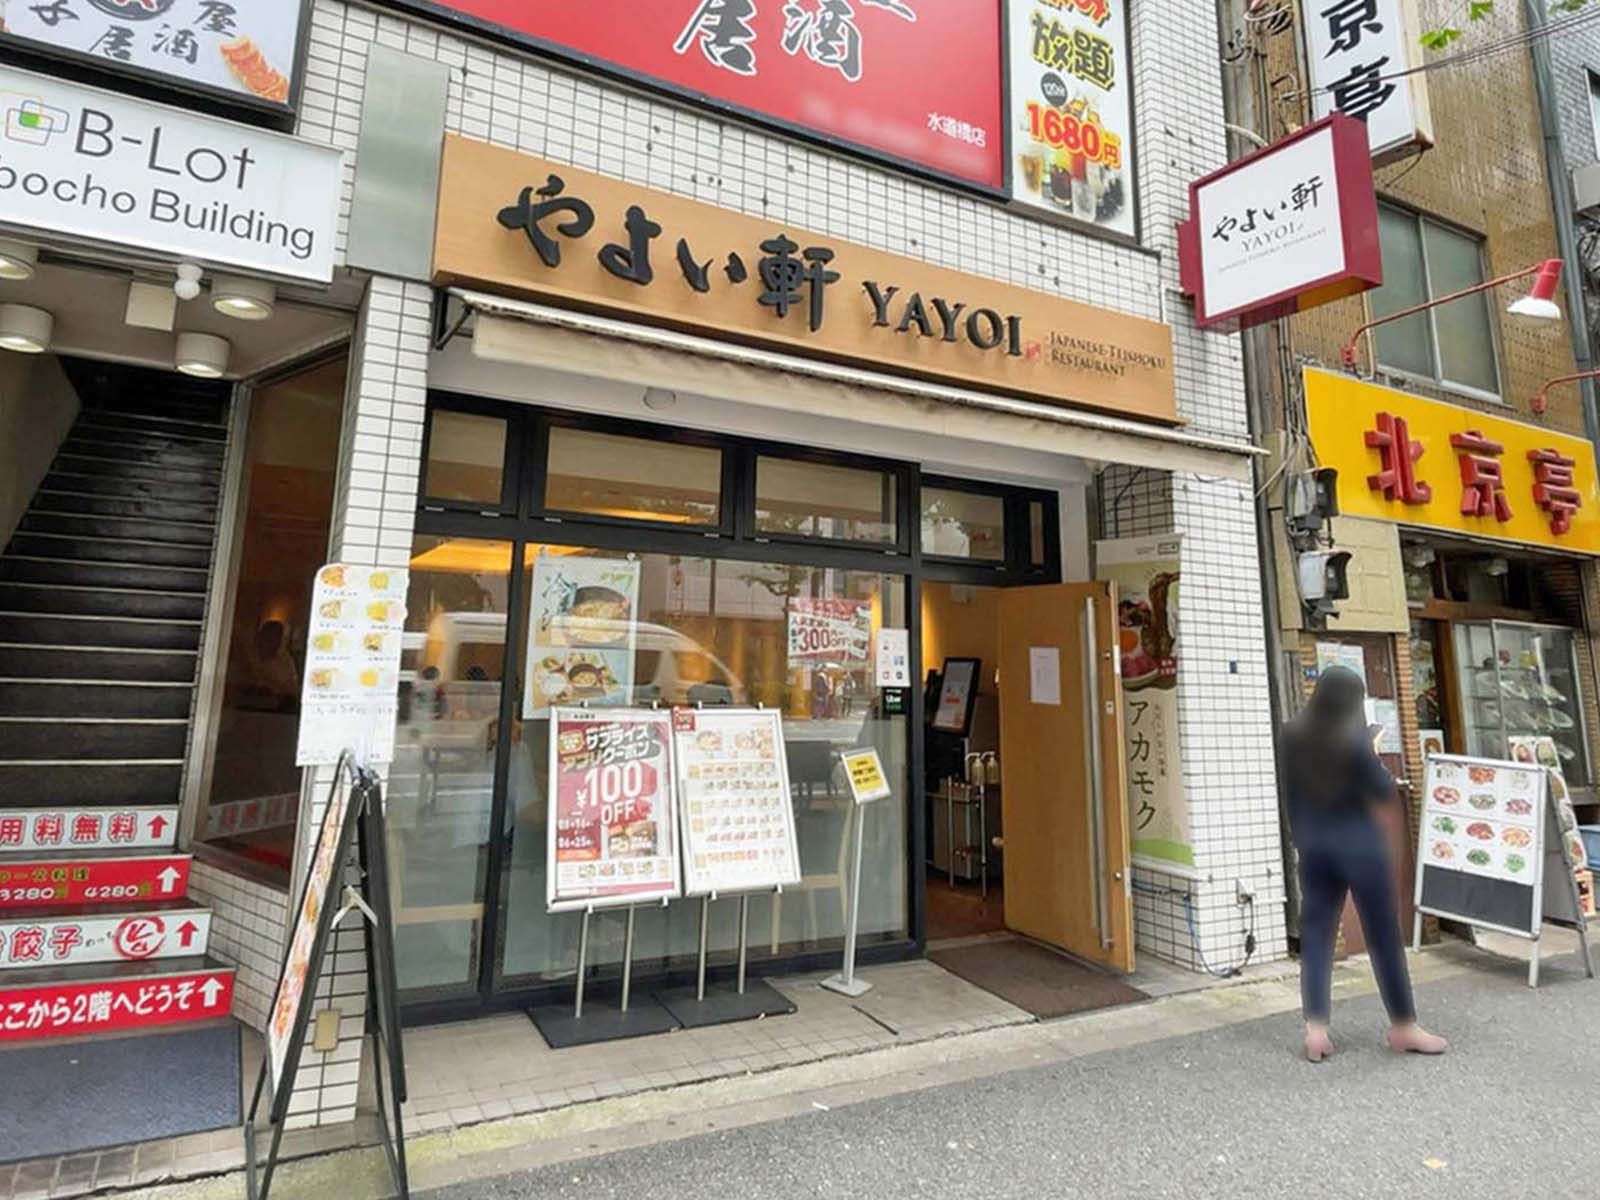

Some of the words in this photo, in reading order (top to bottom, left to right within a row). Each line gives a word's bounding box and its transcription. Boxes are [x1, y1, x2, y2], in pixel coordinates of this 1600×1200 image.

[1031, 14, 1115, 89] 放題
[75, 108, 255, 190] B-Lot
[1026, 102, 1121, 167] 1680円
[149, 188, 315, 260] Building
[1212, 176, 1324, 242] やよい軒
[1240, 222, 1296, 253] YAYOI
[497, 174, 841, 332] やよい軒
[863, 280, 1023, 357] YAYOI
[1364, 412, 1582, 536] 北京亭
[575, 760, 642, 808] ¥100
[1128, 700, 1156, 831] アカモク
[601, 799, 636, 825] OFF
